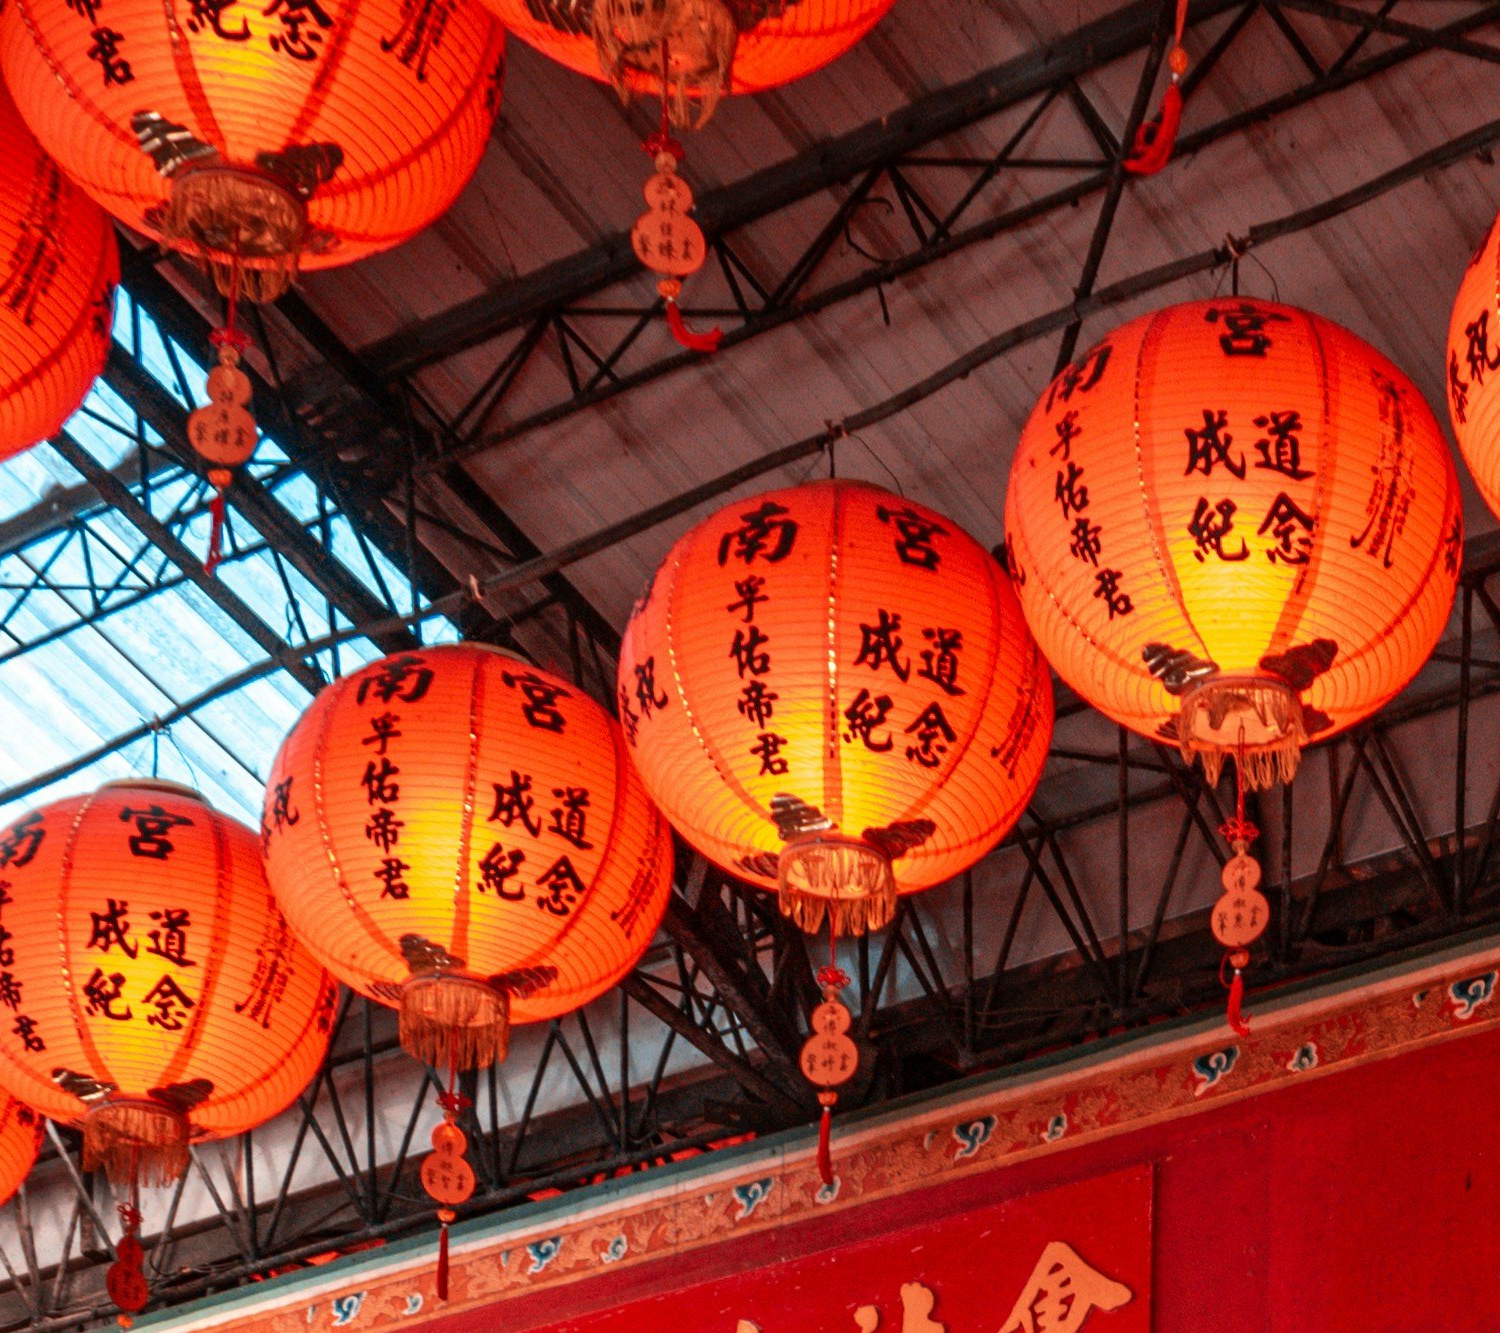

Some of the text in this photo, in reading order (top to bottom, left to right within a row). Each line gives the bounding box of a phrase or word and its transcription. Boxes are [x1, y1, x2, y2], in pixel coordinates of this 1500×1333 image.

[1183, 406, 1317, 483] 成道
[1049, 411, 1135, 620] 孚佑帝君
[1183, 491, 1317, 567] 紀念
[726, 573, 789, 777] 孚佑帝君
[853, 608, 967, 698] 成道
[841, 688, 959, 770] 紀念
[360, 710, 411, 901] 孚佑帝君
[487, 770, 595, 852] 成道
[474, 842, 589, 918] 紀念
[86, 899, 197, 968] 成道
[82, 967, 194, 1033] 紀念
